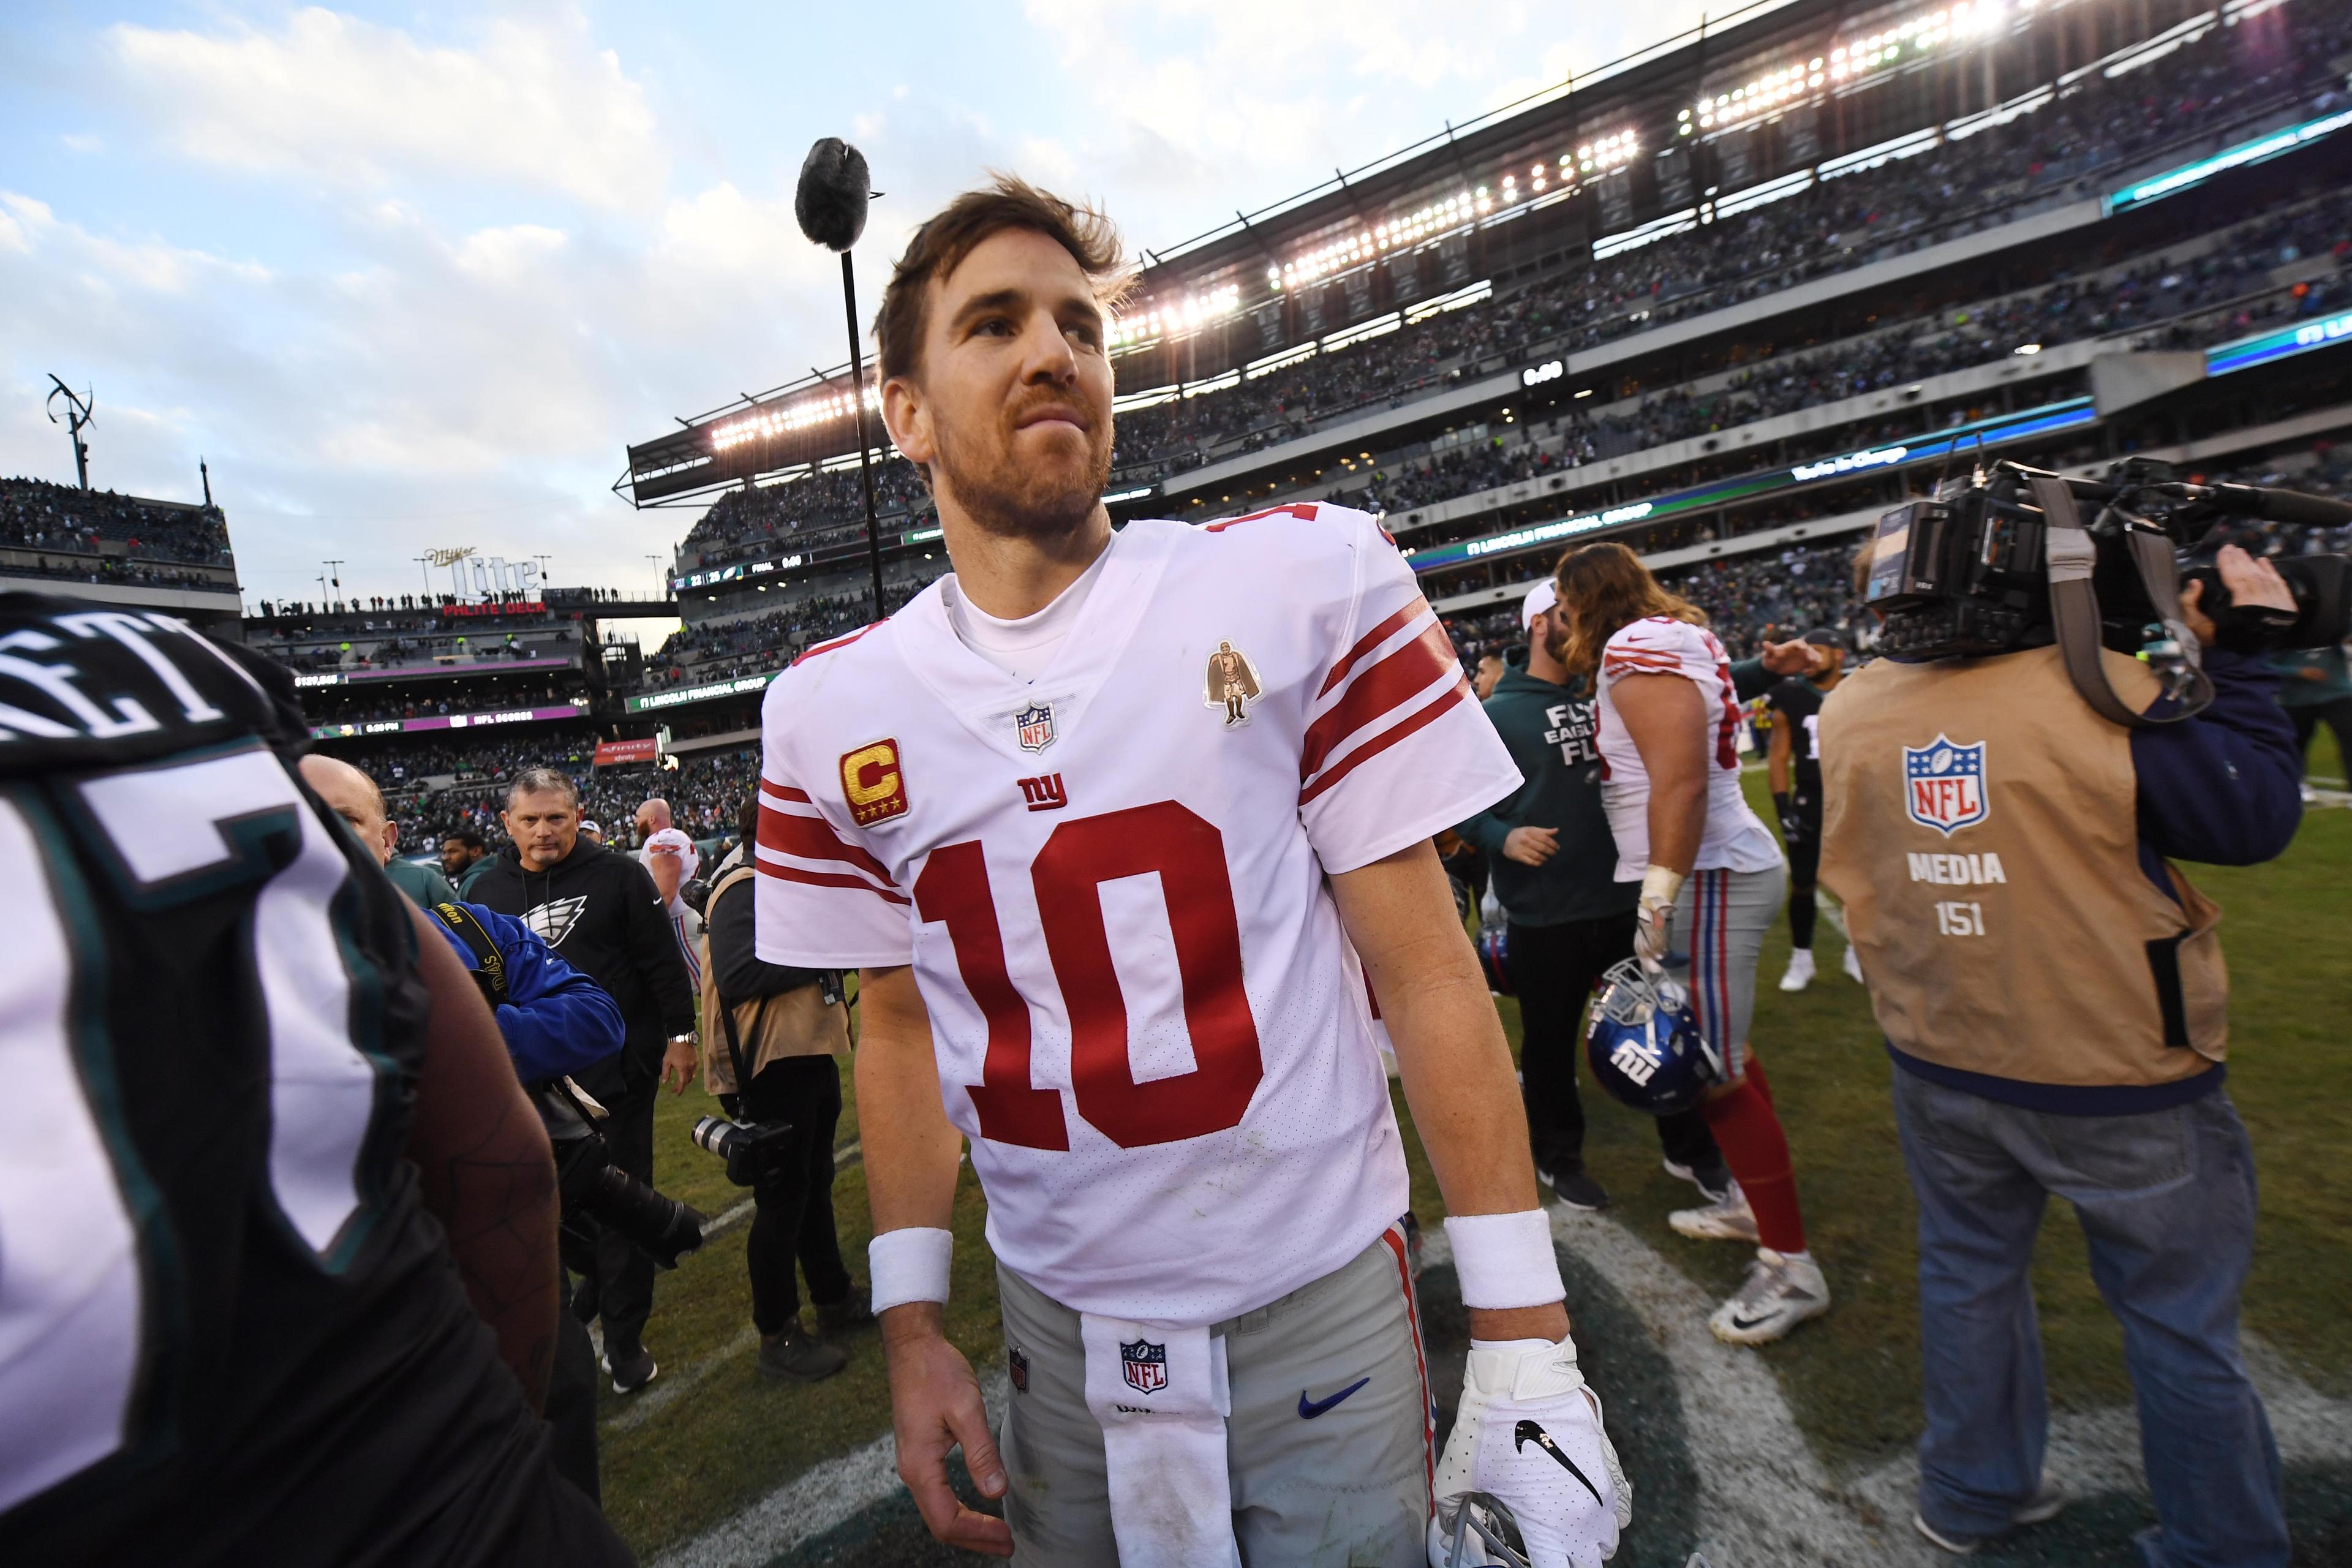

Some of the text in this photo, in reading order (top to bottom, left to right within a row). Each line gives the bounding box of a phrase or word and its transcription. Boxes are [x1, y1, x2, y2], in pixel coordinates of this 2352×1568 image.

[1523, 360, 1562, 386] 0:00
[752, 561, 774, 573] FINAL
[782, 555, 802, 568] 0:00
[451, 557, 539, 603] Lite
[690, 575, 703, 586] 22
[709, 570, 720, 583] 25
[442, 601, 547, 617] PHLITE DECK
[473, 714, 495, 725] NFL
[495, 710, 533, 723] SCORES
[1545, 699, 1597, 728] FLY
[1022, 723, 1050, 745] NFL
[842, 744, 899, 805] C
[1914, 778, 1977, 821] NFL
[1906, 851, 2008, 885] MEDIA
[1934, 900, 1986, 937] 151
[912, 799, 1264, 1152] 10
[1126, 1362, 1164, 1389] NFL
